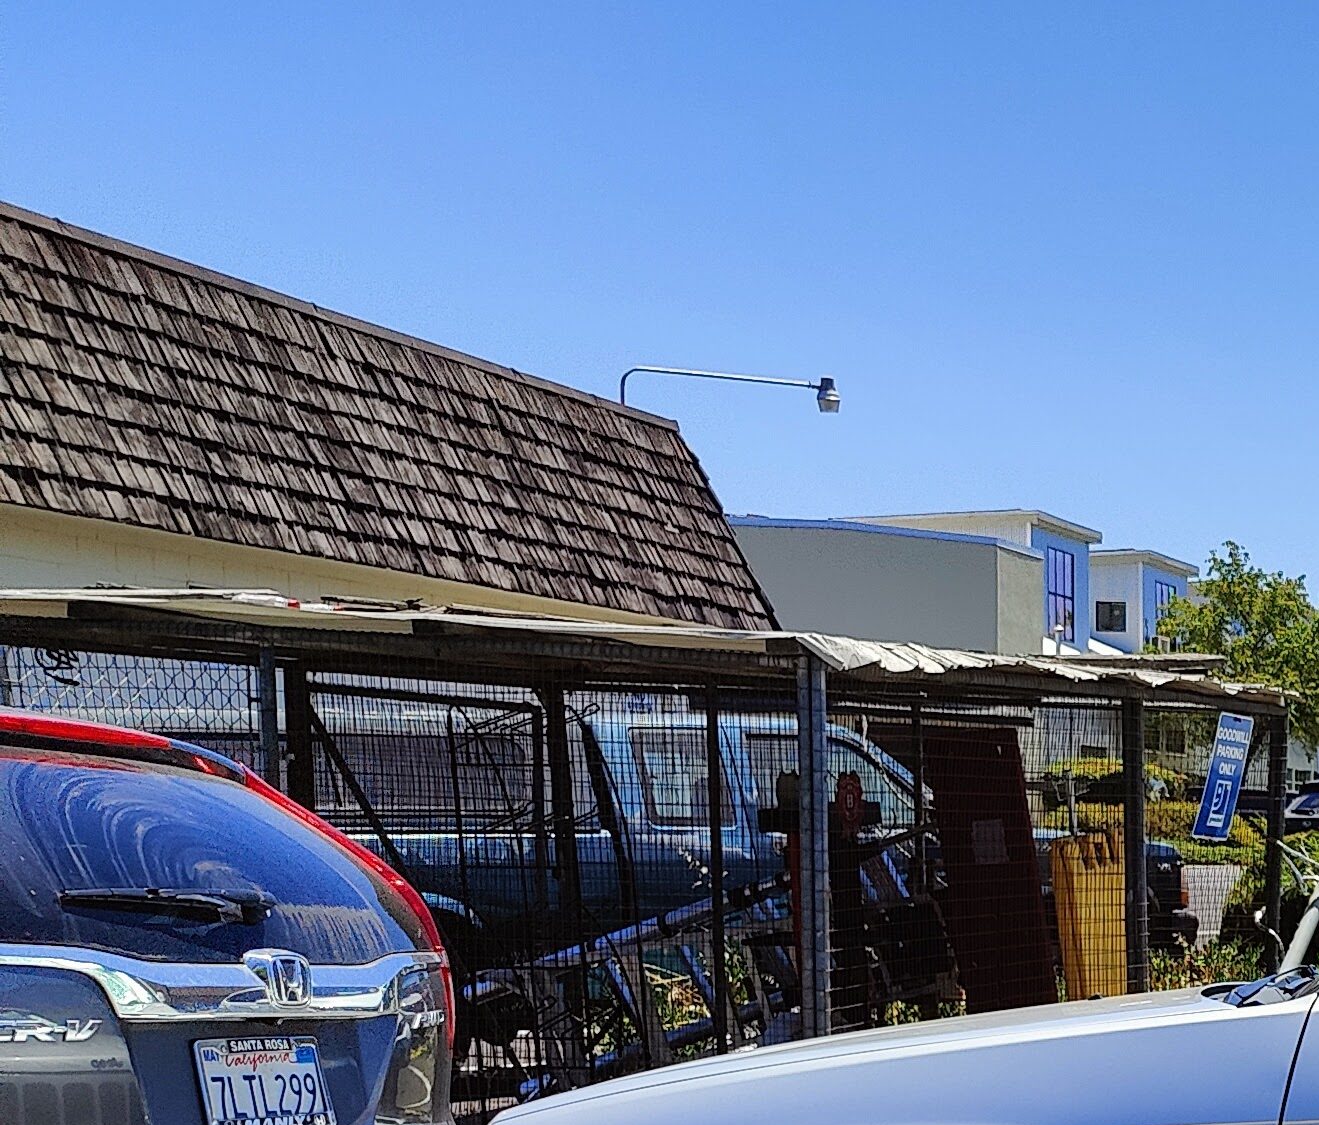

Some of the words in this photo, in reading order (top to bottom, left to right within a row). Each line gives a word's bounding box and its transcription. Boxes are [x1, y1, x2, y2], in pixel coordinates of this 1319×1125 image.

[1217, 727, 1249, 743] GOODWILL
[1216, 743, 1244, 760] PARKING
[1218, 762, 1236, 776] ONLY
[229, 1039, 262, 1052] SANTA
[264, 1038, 290, 1050] ROSA
[225, 1052, 294, 1072] California
[210, 1072, 317, 1120] 7LTL299
